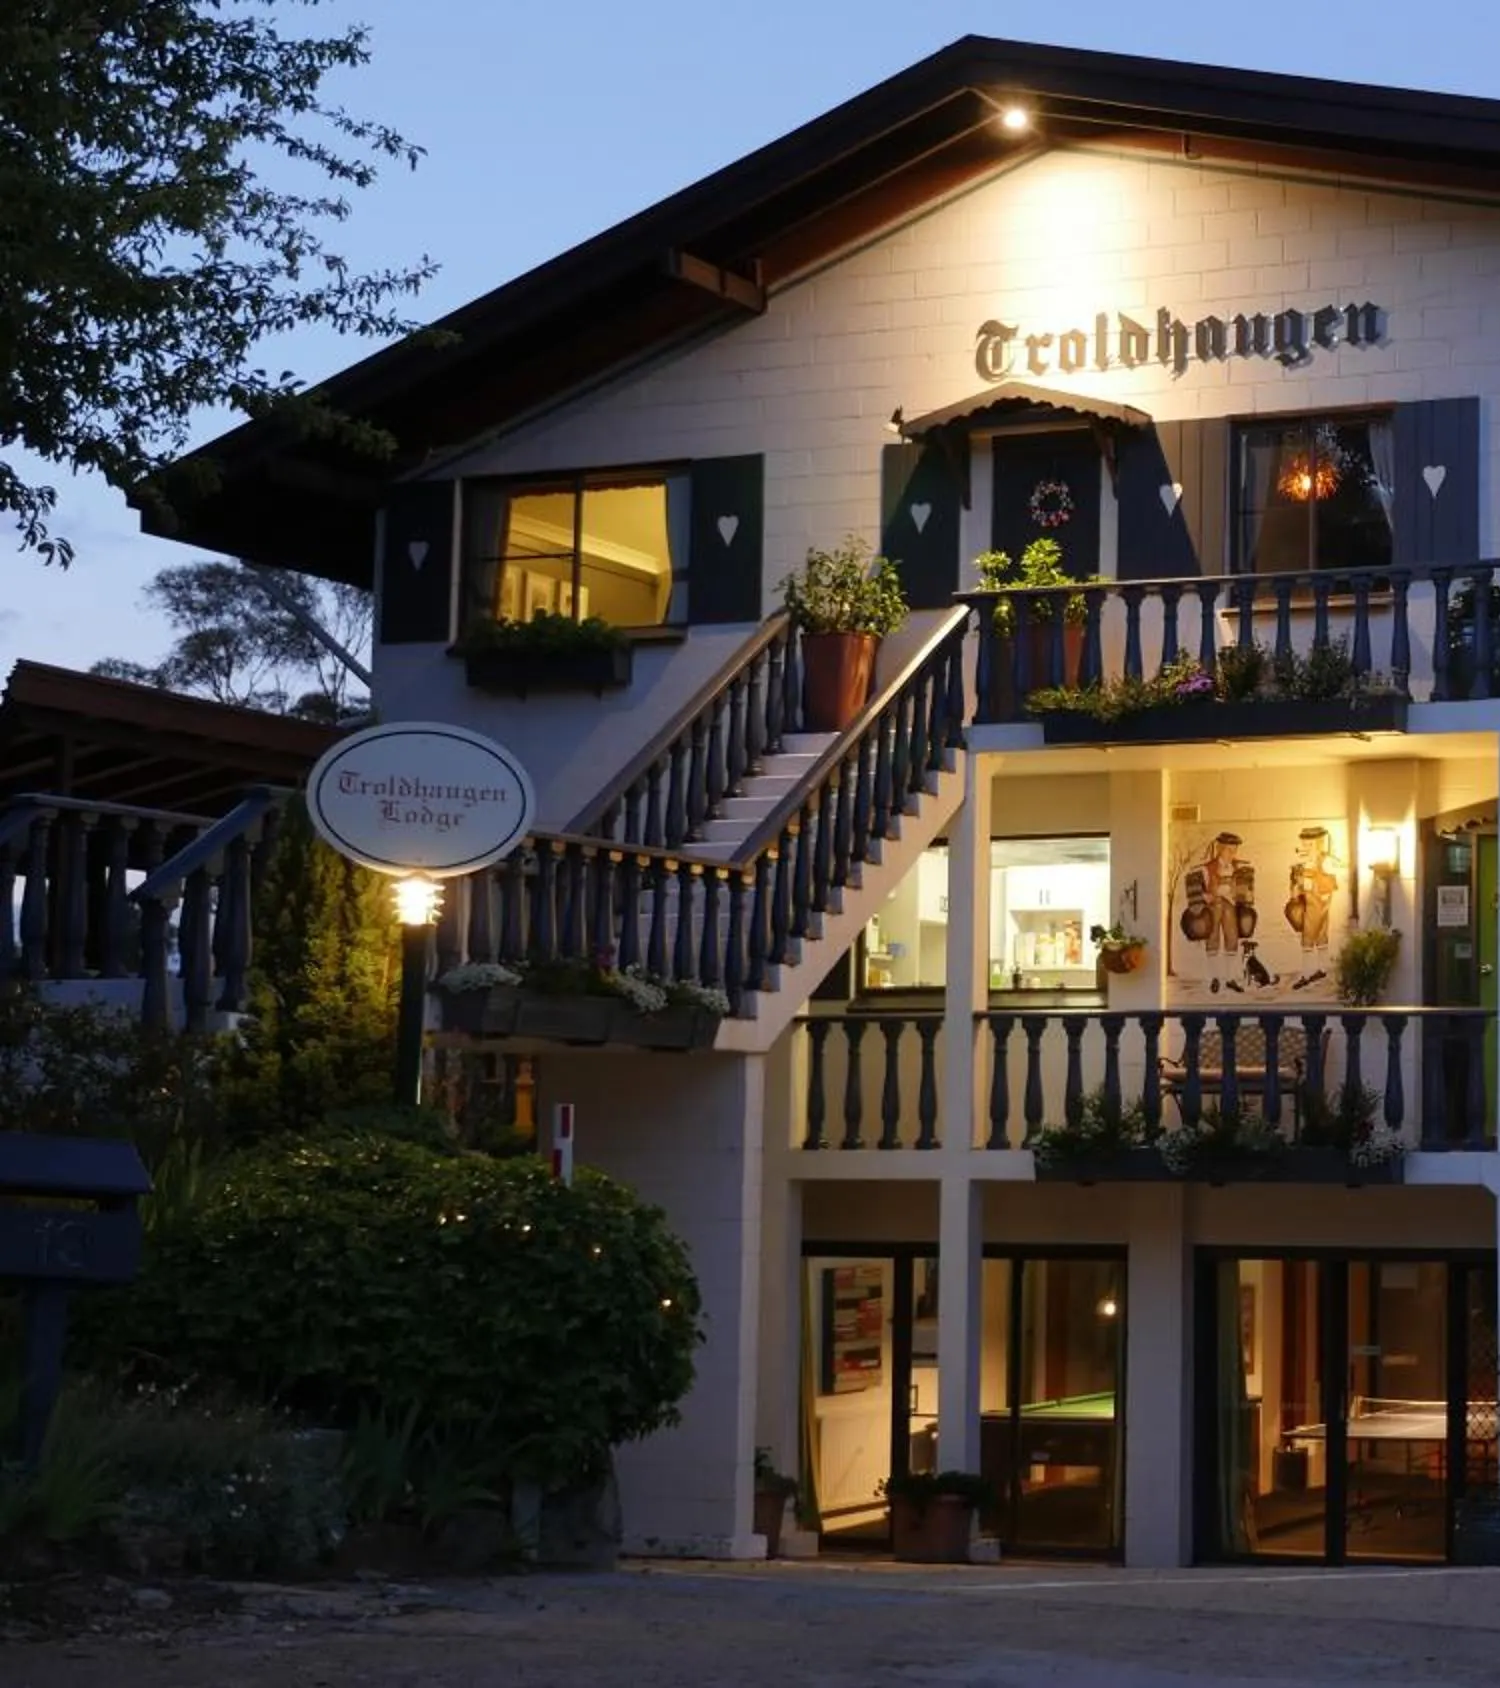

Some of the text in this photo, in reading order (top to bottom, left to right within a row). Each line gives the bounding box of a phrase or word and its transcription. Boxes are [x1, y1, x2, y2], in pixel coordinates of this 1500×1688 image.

[975, 300, 1384, 383] Troldhaugen
[338, 770, 507, 808] Troldhaugen
[378, 799, 466, 832] Lodge
